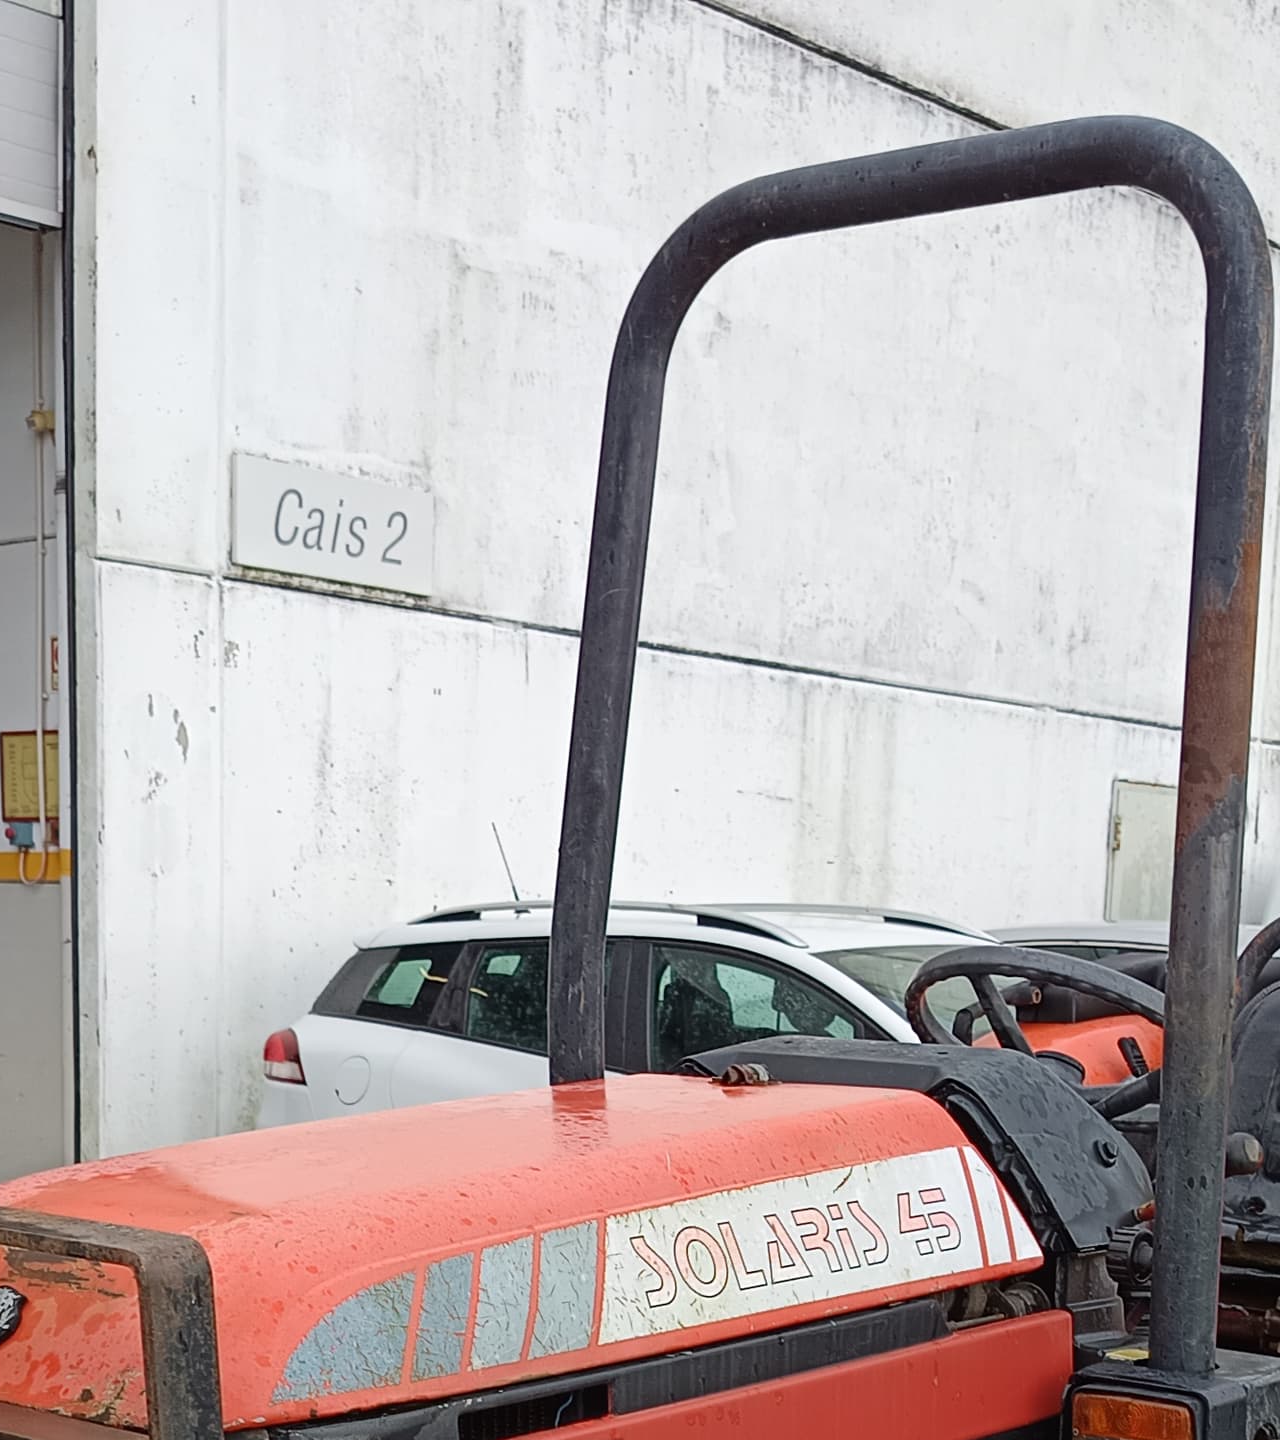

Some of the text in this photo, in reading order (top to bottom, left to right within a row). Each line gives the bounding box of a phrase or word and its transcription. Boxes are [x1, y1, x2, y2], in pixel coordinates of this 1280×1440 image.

[274, 488, 408, 565] Cais 2
[897, 1187, 962, 1256] 45
